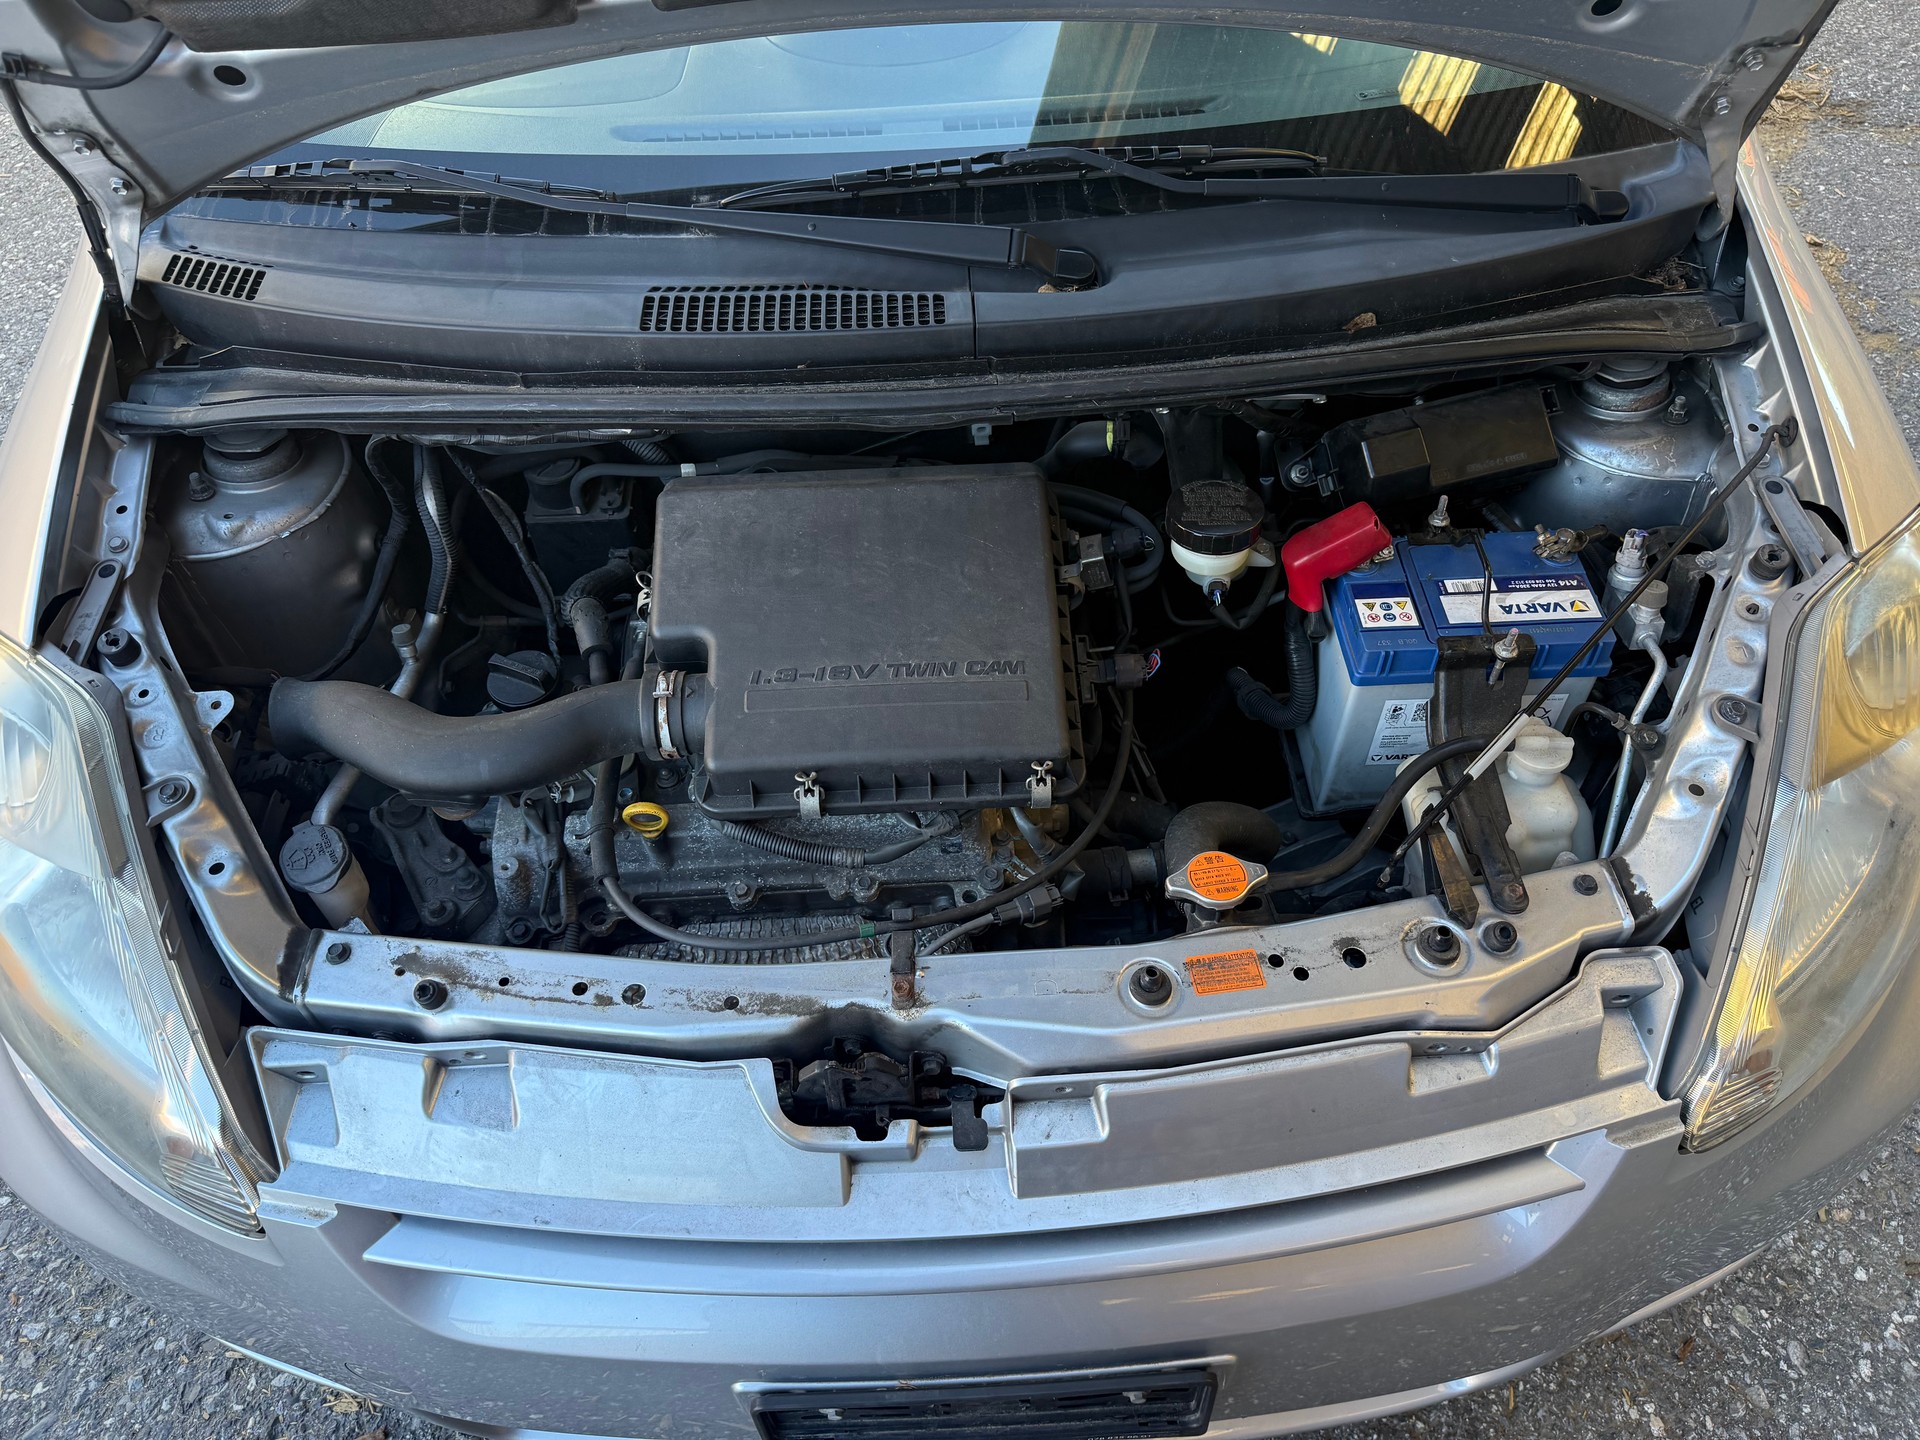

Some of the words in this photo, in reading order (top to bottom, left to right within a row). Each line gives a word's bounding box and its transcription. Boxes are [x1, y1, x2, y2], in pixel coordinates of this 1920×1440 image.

[1558, 579, 1578, 587] A14
[1498, 602, 1568, 614] VARTA
[749, 663, 881, 685] 1.3-16V
[885, 661, 957, 678] TWIN
[964, 659, 1026, 677] CAM
[1215, 885, 1239, 895] WARNING
